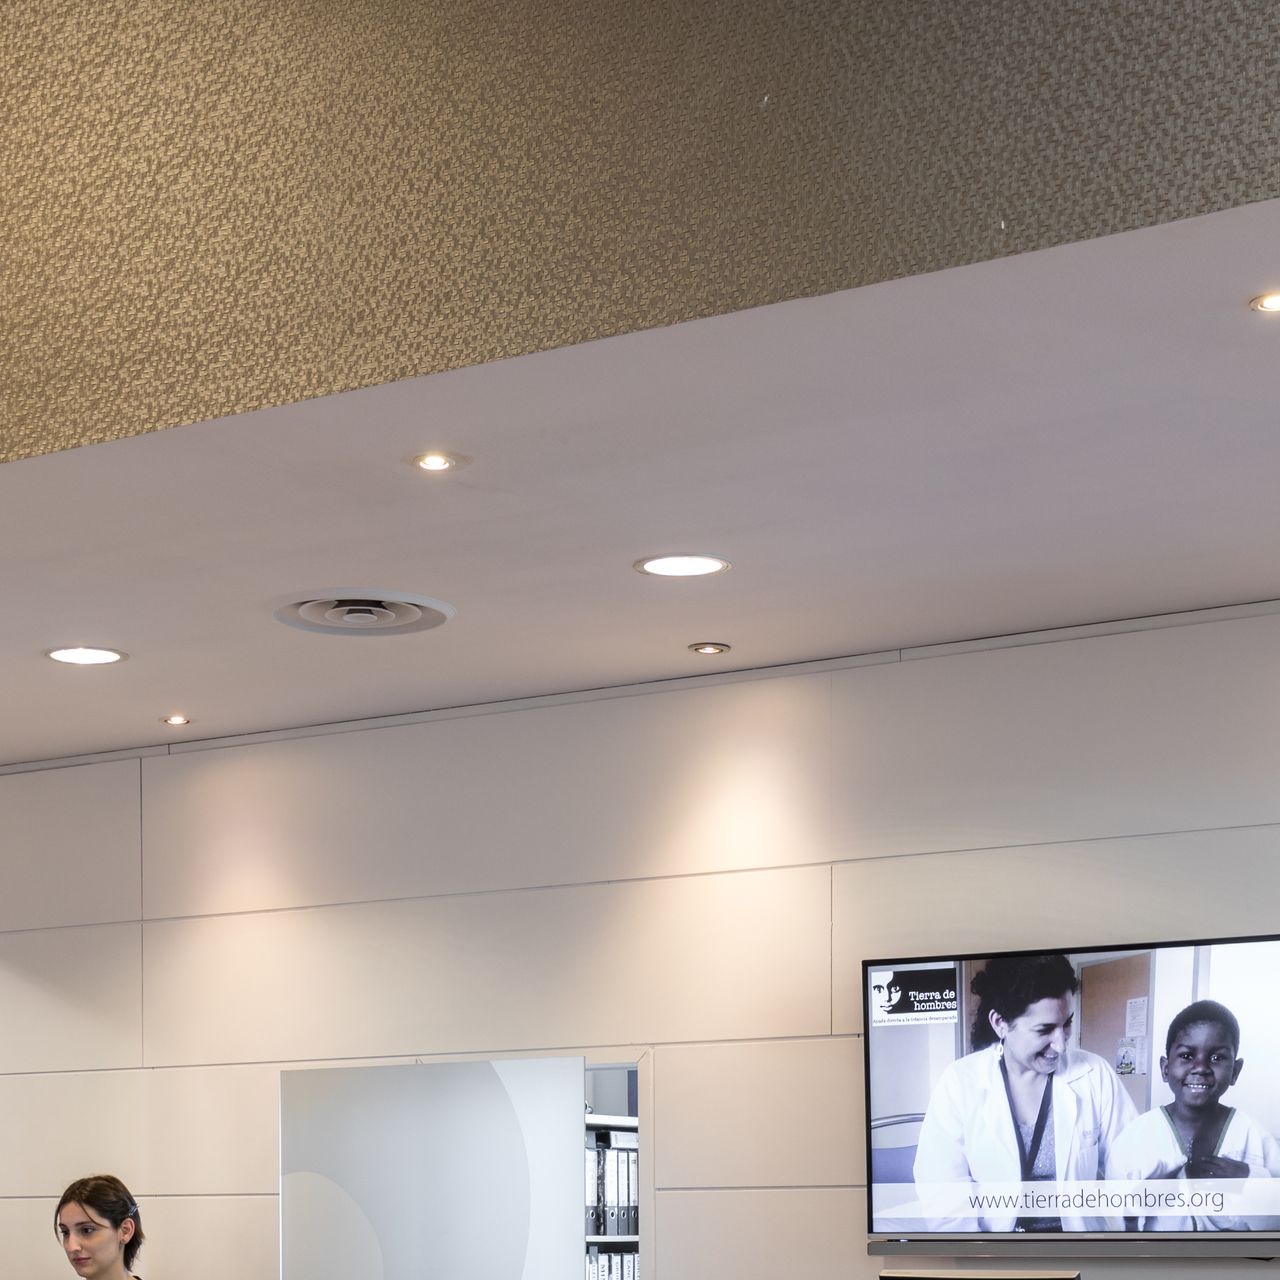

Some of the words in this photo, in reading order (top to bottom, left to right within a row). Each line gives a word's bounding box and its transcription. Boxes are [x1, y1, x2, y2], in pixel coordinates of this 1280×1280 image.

[908, 991, 941, 1001] Tierra
[943, 989, 955, 999] de
[914, 1001, 957, 1011] hombres
[968, 1188, 1224, 1213] www.tierradehombres.org
